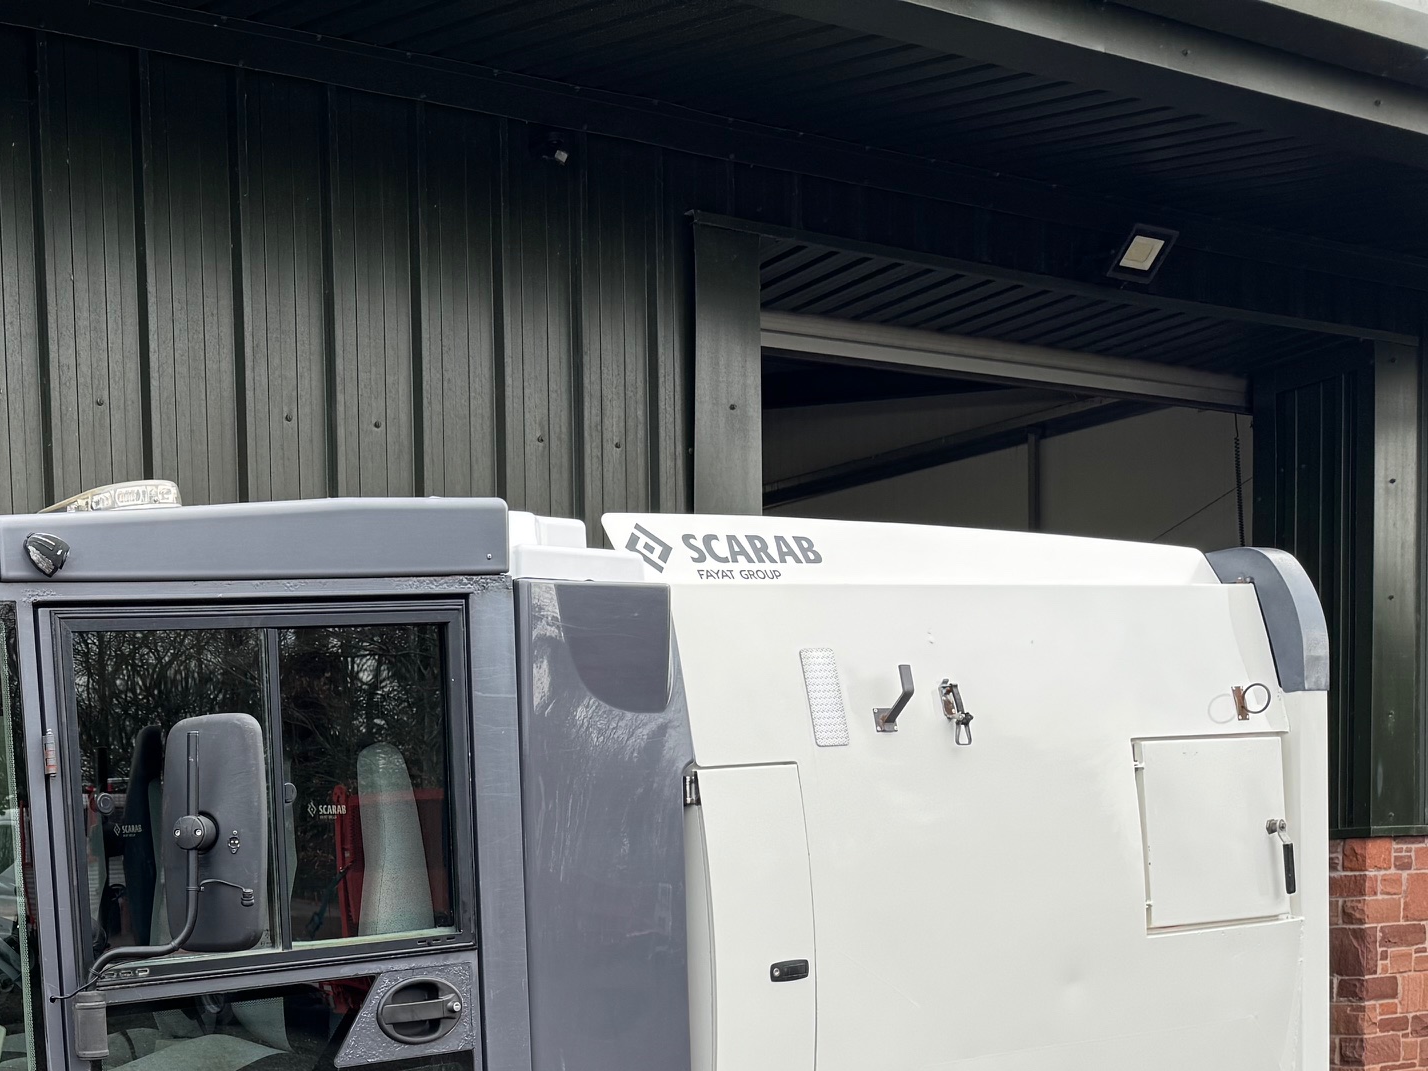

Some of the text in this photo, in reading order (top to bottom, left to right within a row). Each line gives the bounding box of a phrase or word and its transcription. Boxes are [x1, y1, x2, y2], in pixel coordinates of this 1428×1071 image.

[681, 533, 823, 564] SCARAB
[697, 569, 782, 580] FAYAT GROUP
[318, 804, 347, 815] SCARAB
